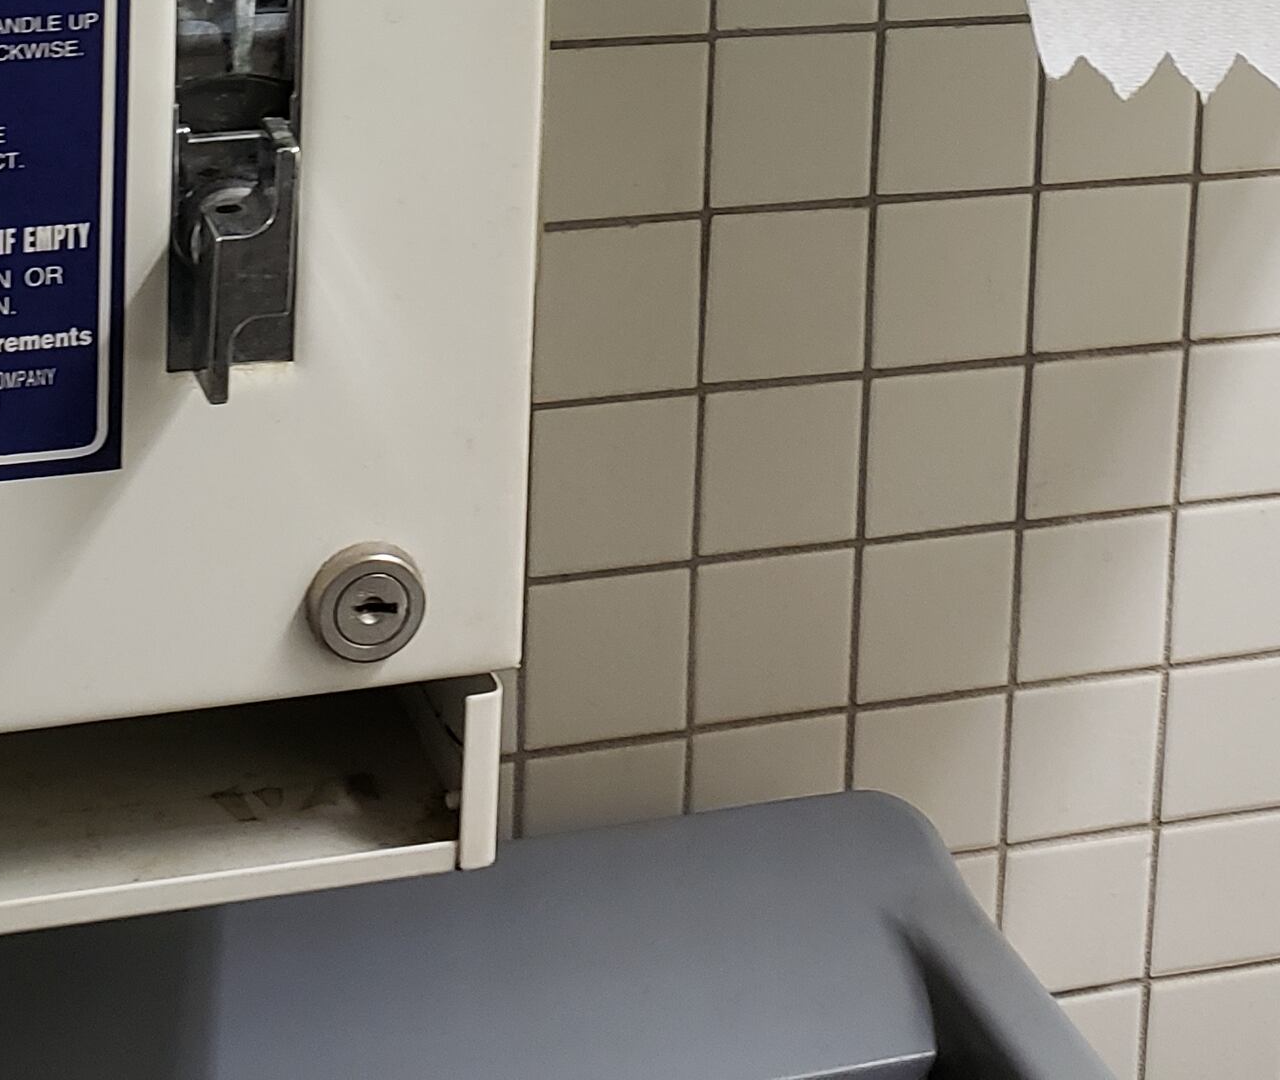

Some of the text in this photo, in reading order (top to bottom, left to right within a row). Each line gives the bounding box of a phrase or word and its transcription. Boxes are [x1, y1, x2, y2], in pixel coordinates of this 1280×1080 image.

[69, 12, 100, 31] UP
[22, 222, 91, 254] EMPTY
[23, 265, 64, 287] OR
